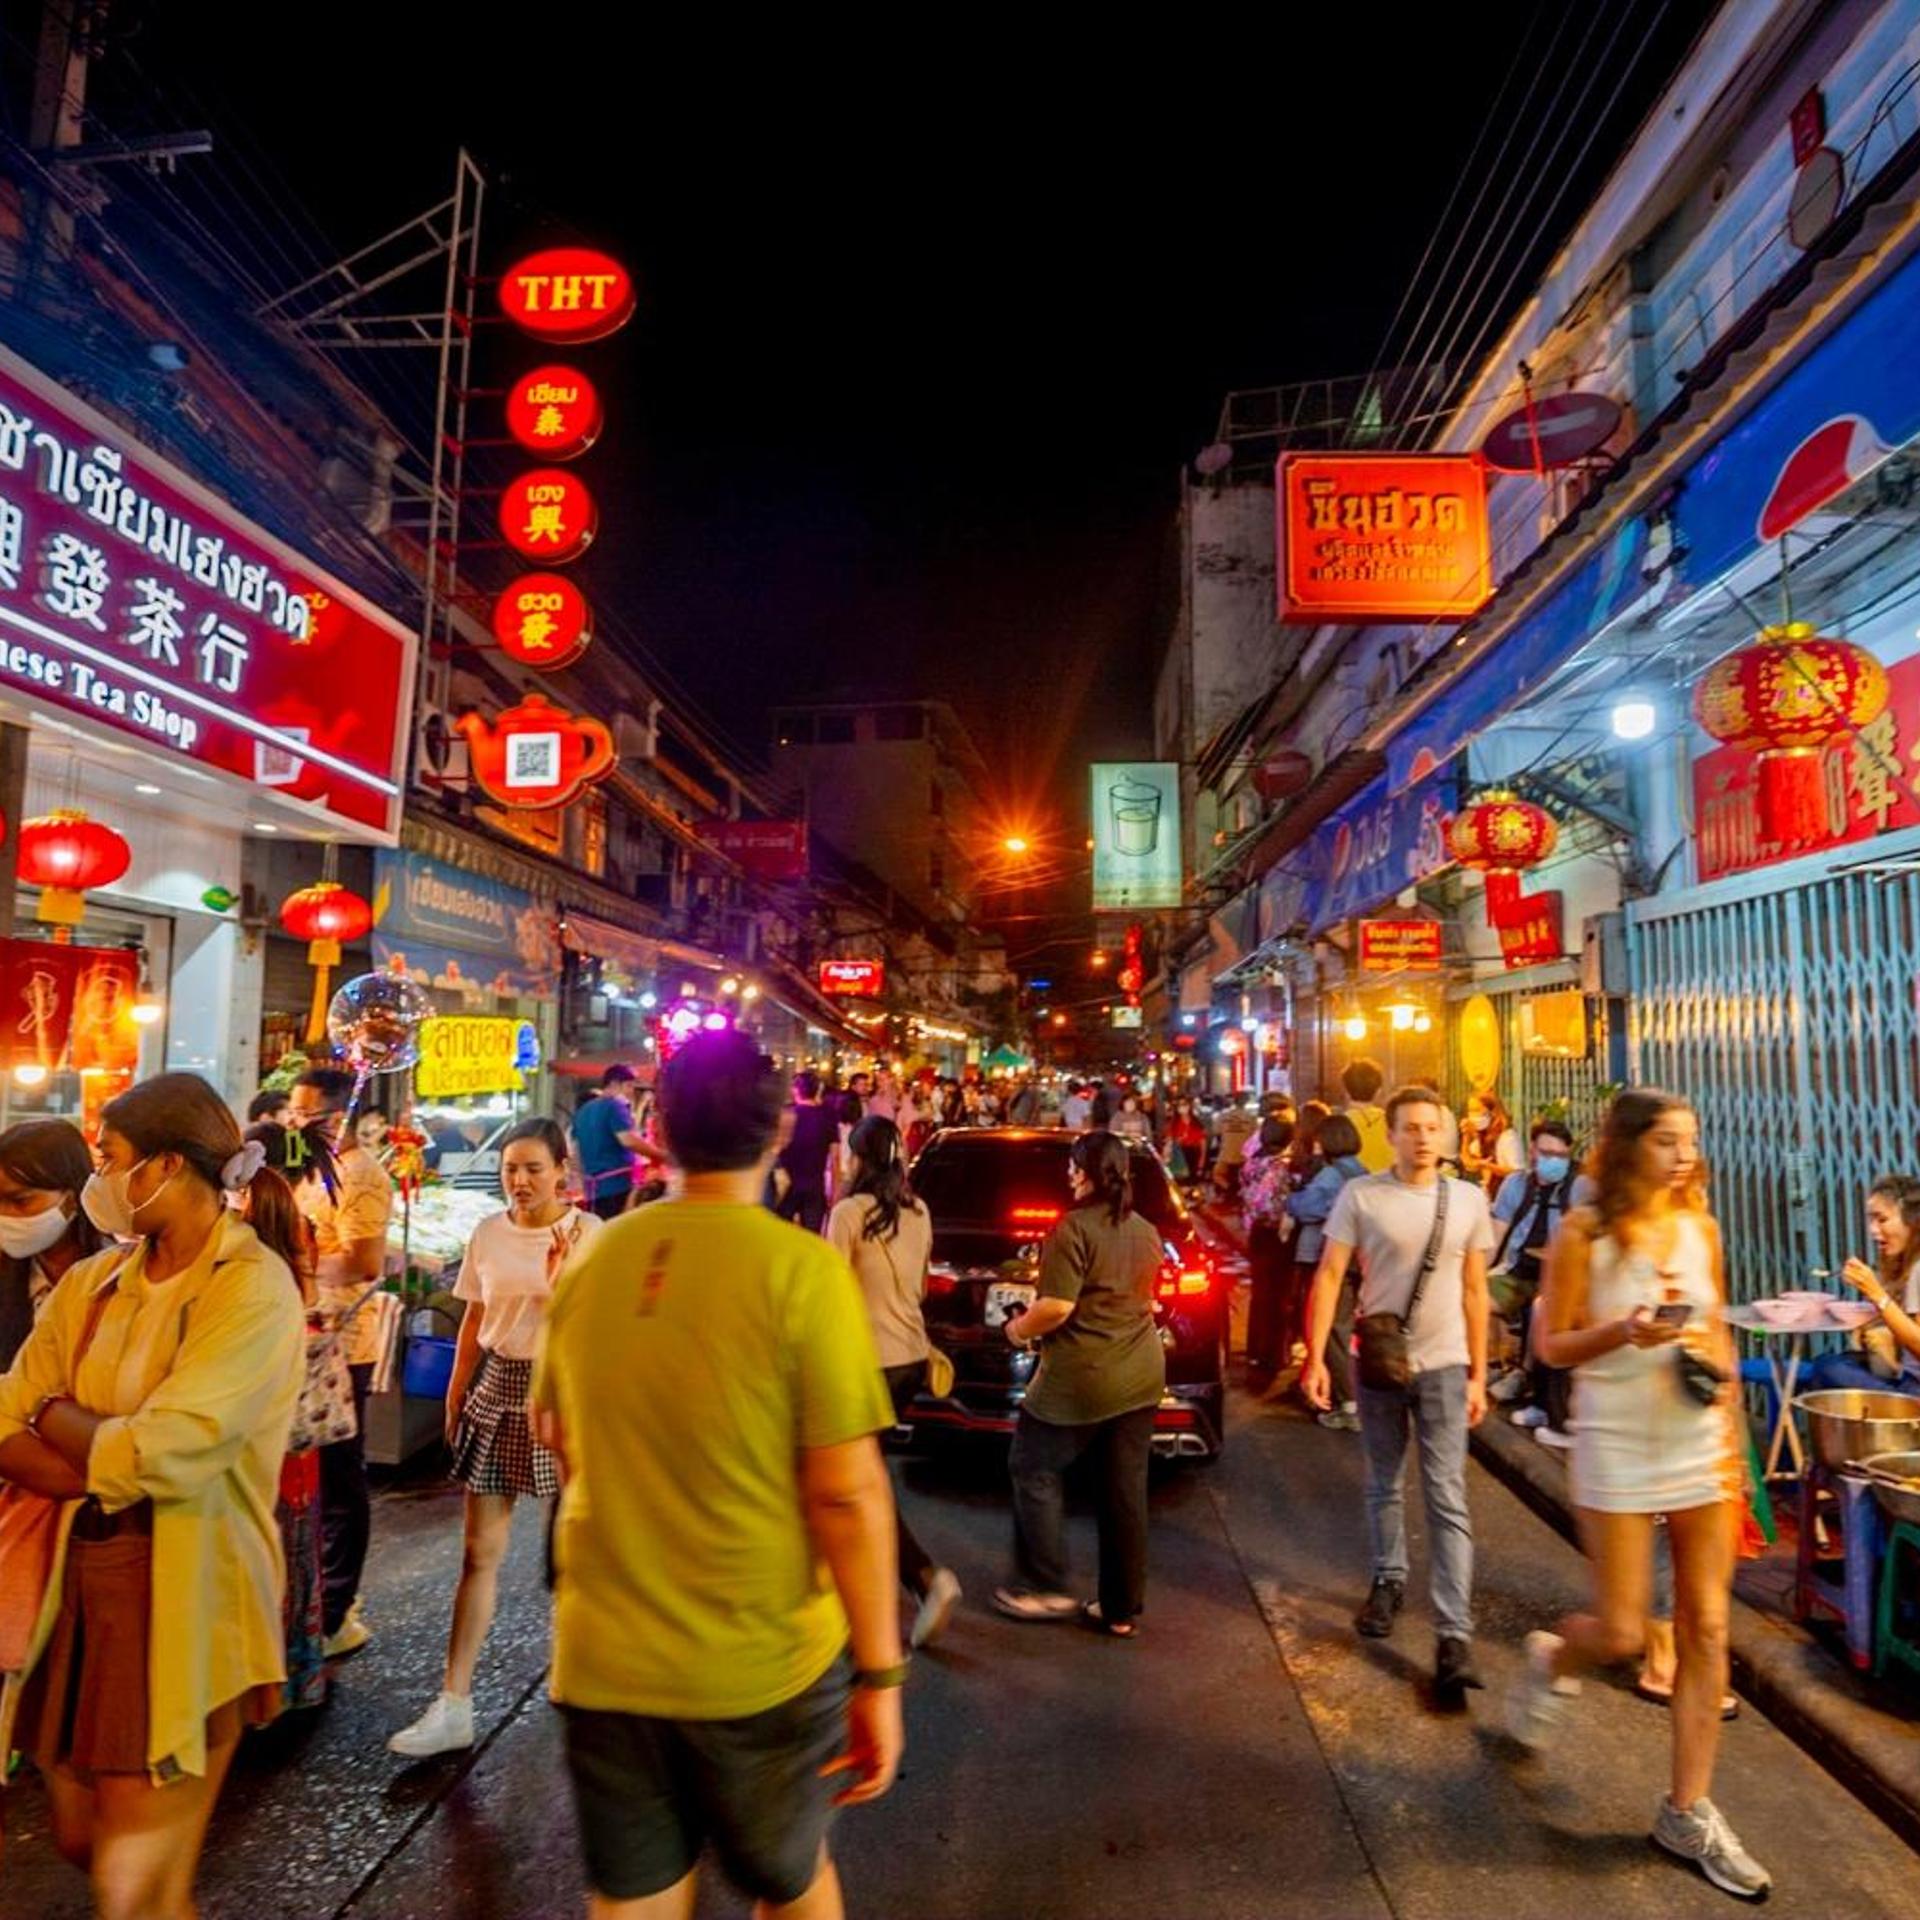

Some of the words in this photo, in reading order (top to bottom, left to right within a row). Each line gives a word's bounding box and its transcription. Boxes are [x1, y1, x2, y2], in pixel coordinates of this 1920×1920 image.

[517, 275, 616, 310] THT
[71, 661, 126, 714] Tea
[133, 690, 197, 750] Shop
